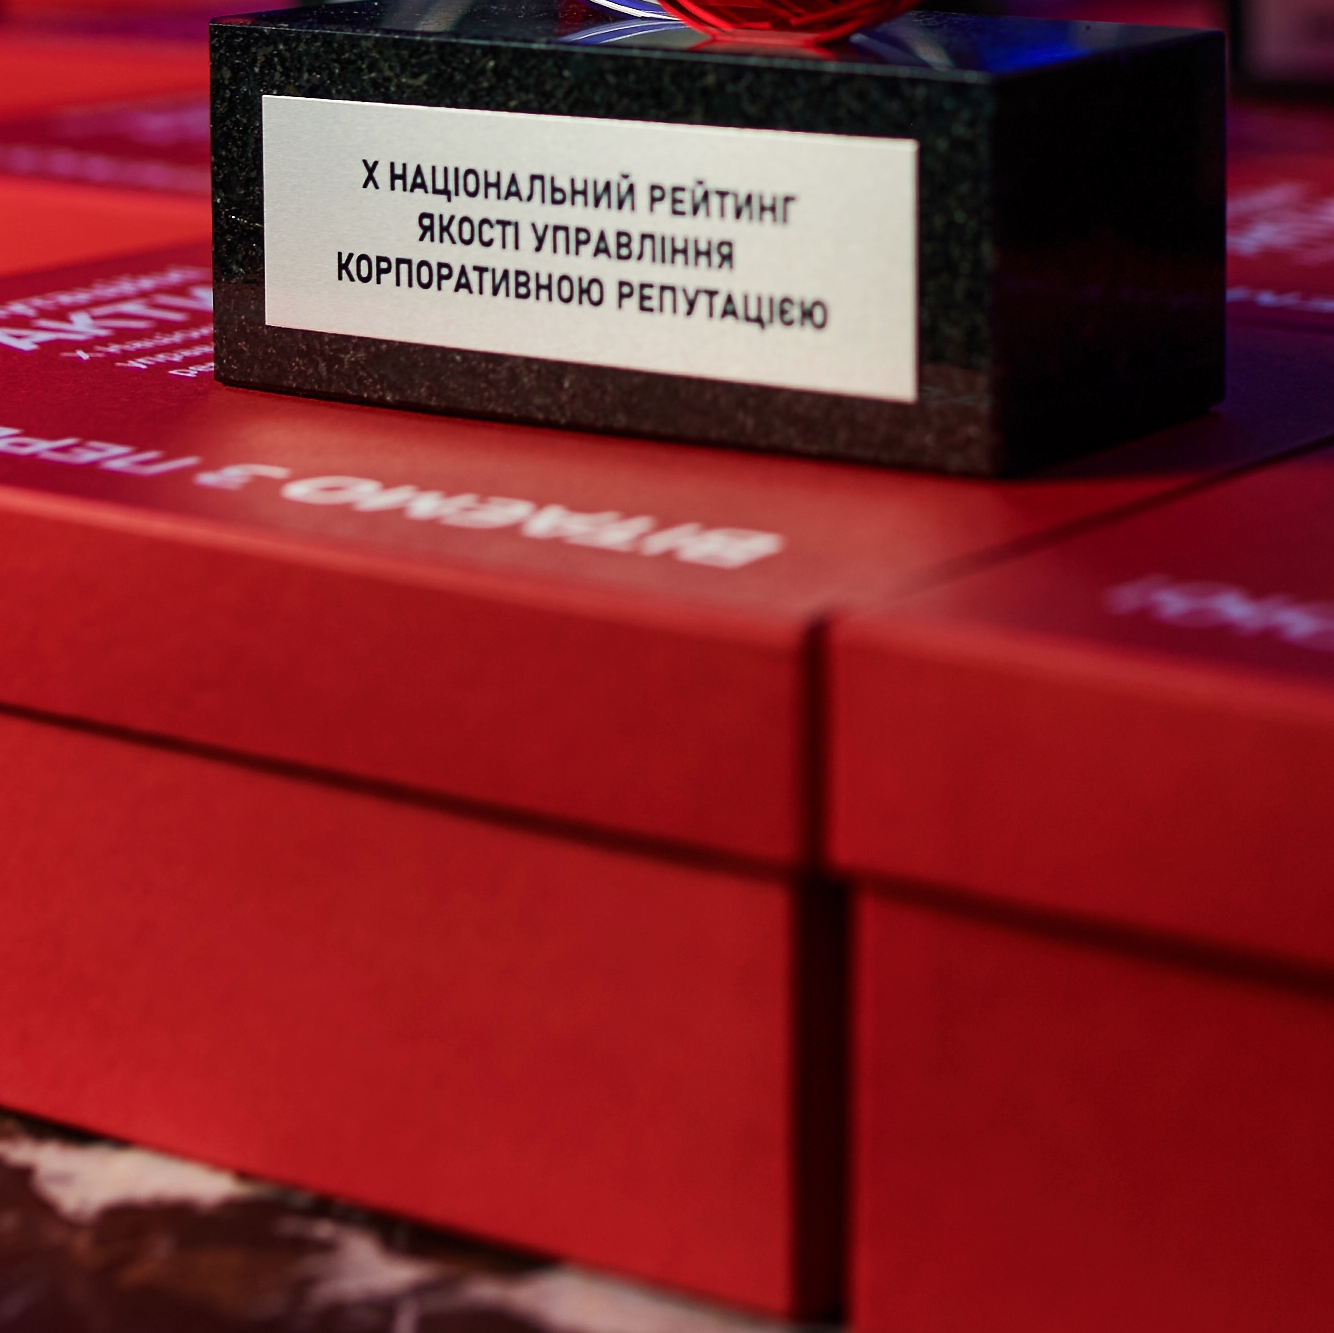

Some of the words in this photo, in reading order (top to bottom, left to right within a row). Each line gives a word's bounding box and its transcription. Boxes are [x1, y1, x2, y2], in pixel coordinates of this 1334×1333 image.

[389, 161, 636, 213] НАЦІОНАЛЬНИЙ
[649, 178, 797, 225] РЕЙТИНГ
[417, 212, 520, 252] ЯКОСТІ
[532, 223, 734, 270] УПРАВЛІННЯ
[336, 251, 605, 309] КОРПОРАТИВНОЮ
[617, 280, 828, 331] РЕПУТАЦІЄЮ
